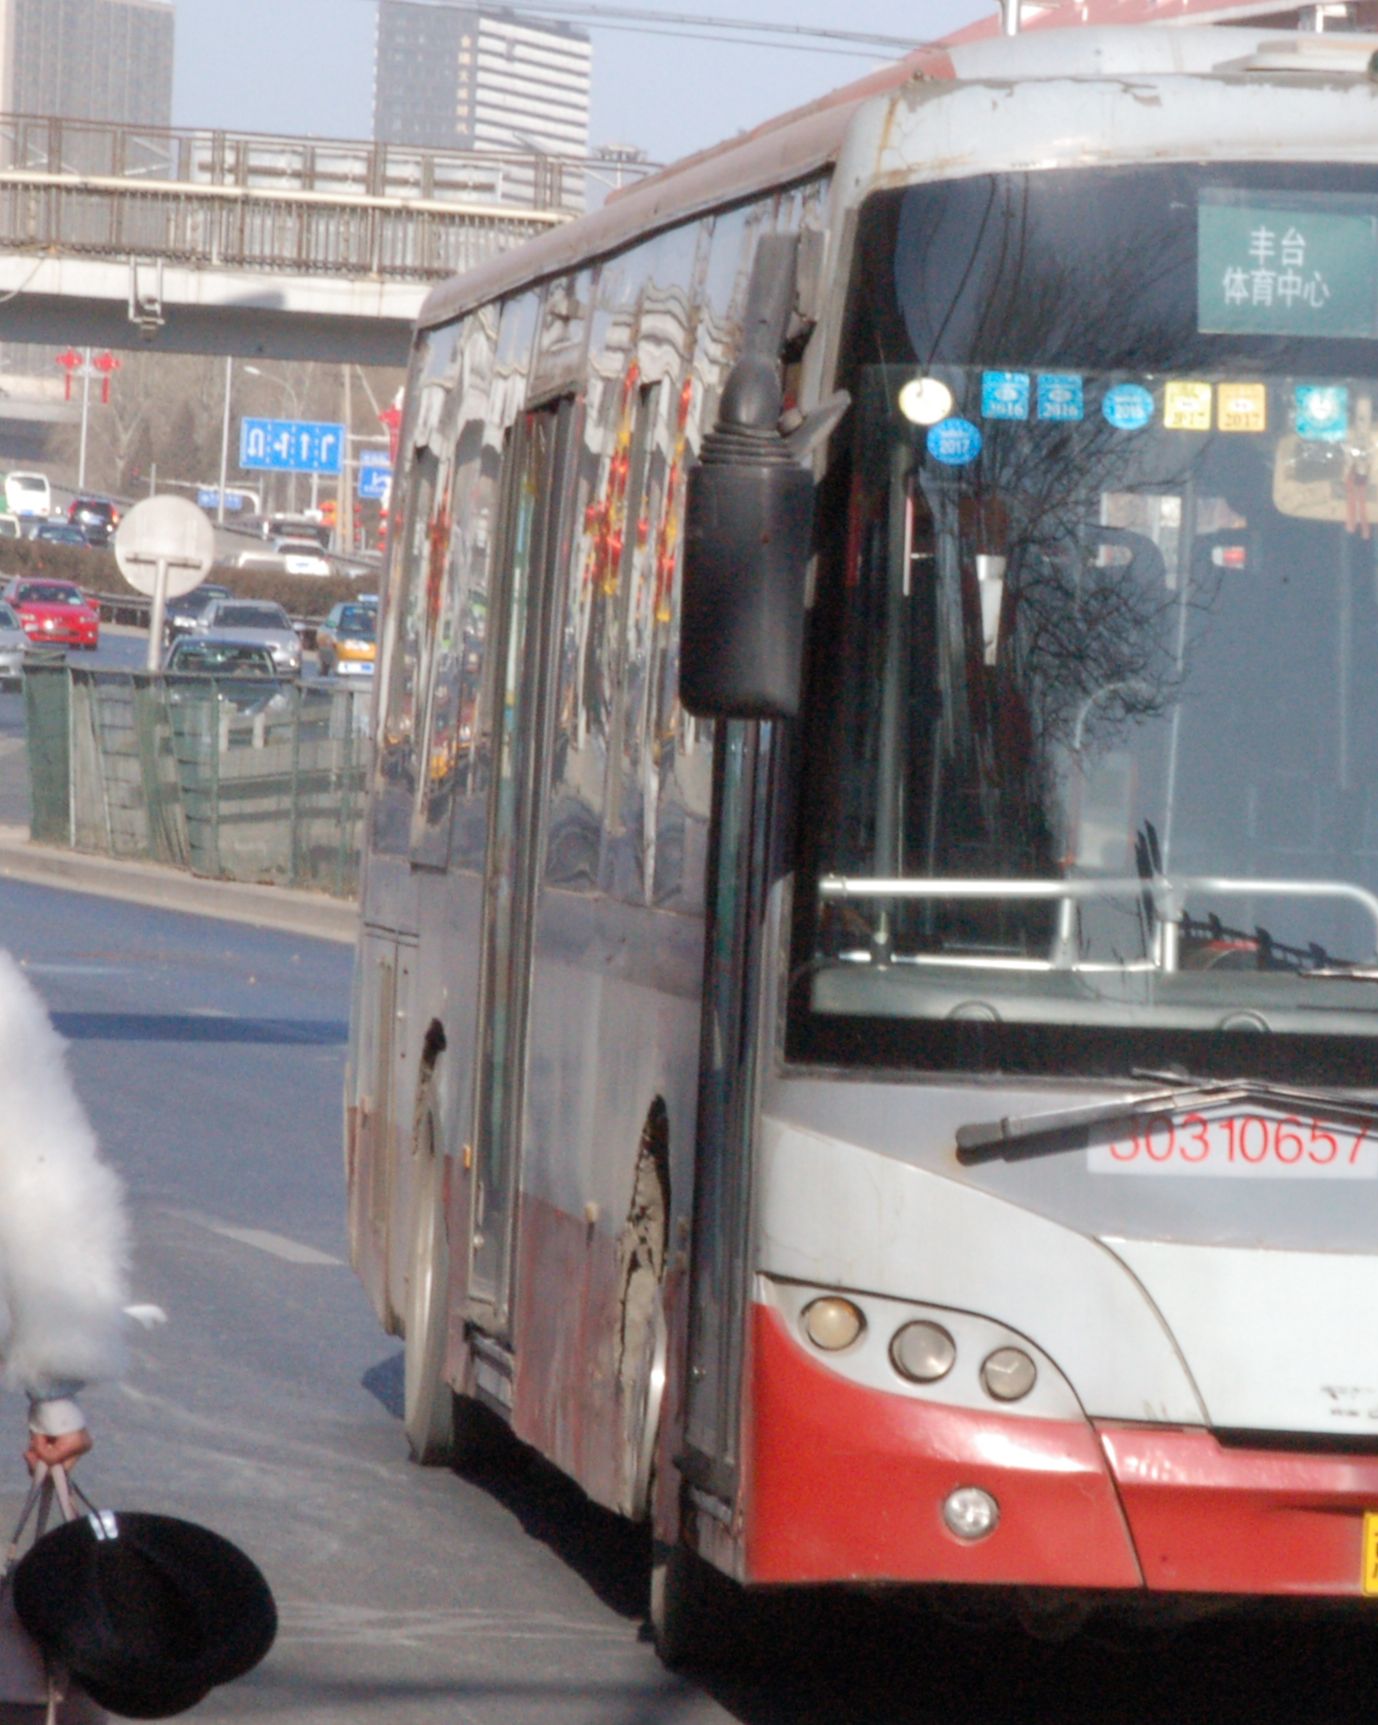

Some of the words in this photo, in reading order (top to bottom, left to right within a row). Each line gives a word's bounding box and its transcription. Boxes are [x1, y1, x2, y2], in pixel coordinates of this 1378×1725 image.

[1248, 225, 1306, 267] 丰台
[1222, 266, 1331, 308] 体育中心
